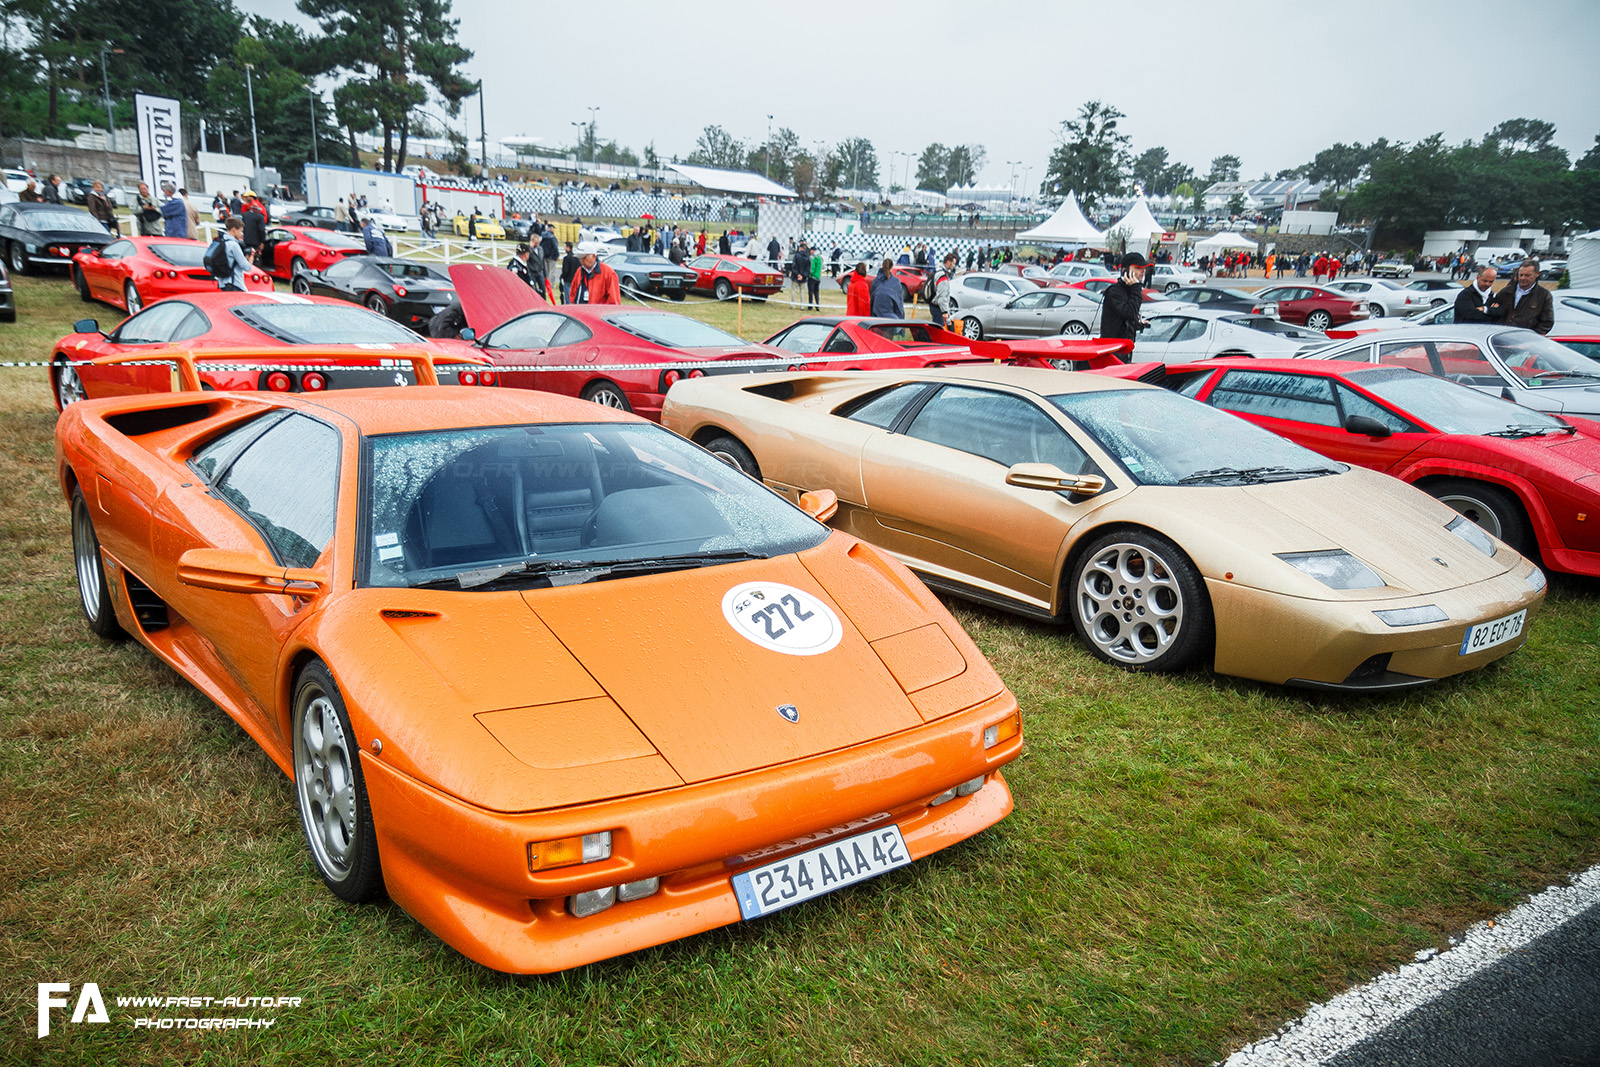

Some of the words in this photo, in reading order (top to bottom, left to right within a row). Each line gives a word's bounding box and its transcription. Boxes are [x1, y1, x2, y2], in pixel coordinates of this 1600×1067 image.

[145, 106, 177, 198] rrari
[751, 593, 815, 640] 272
[1472, 626, 1488, 648] 82
[1489, 619, 1510, 643] ECF
[755, 859, 814, 907] 234
[818, 842, 871, 886] AAA
[872, 832, 904, 866] 42
[746, 900, 752, 911] F
